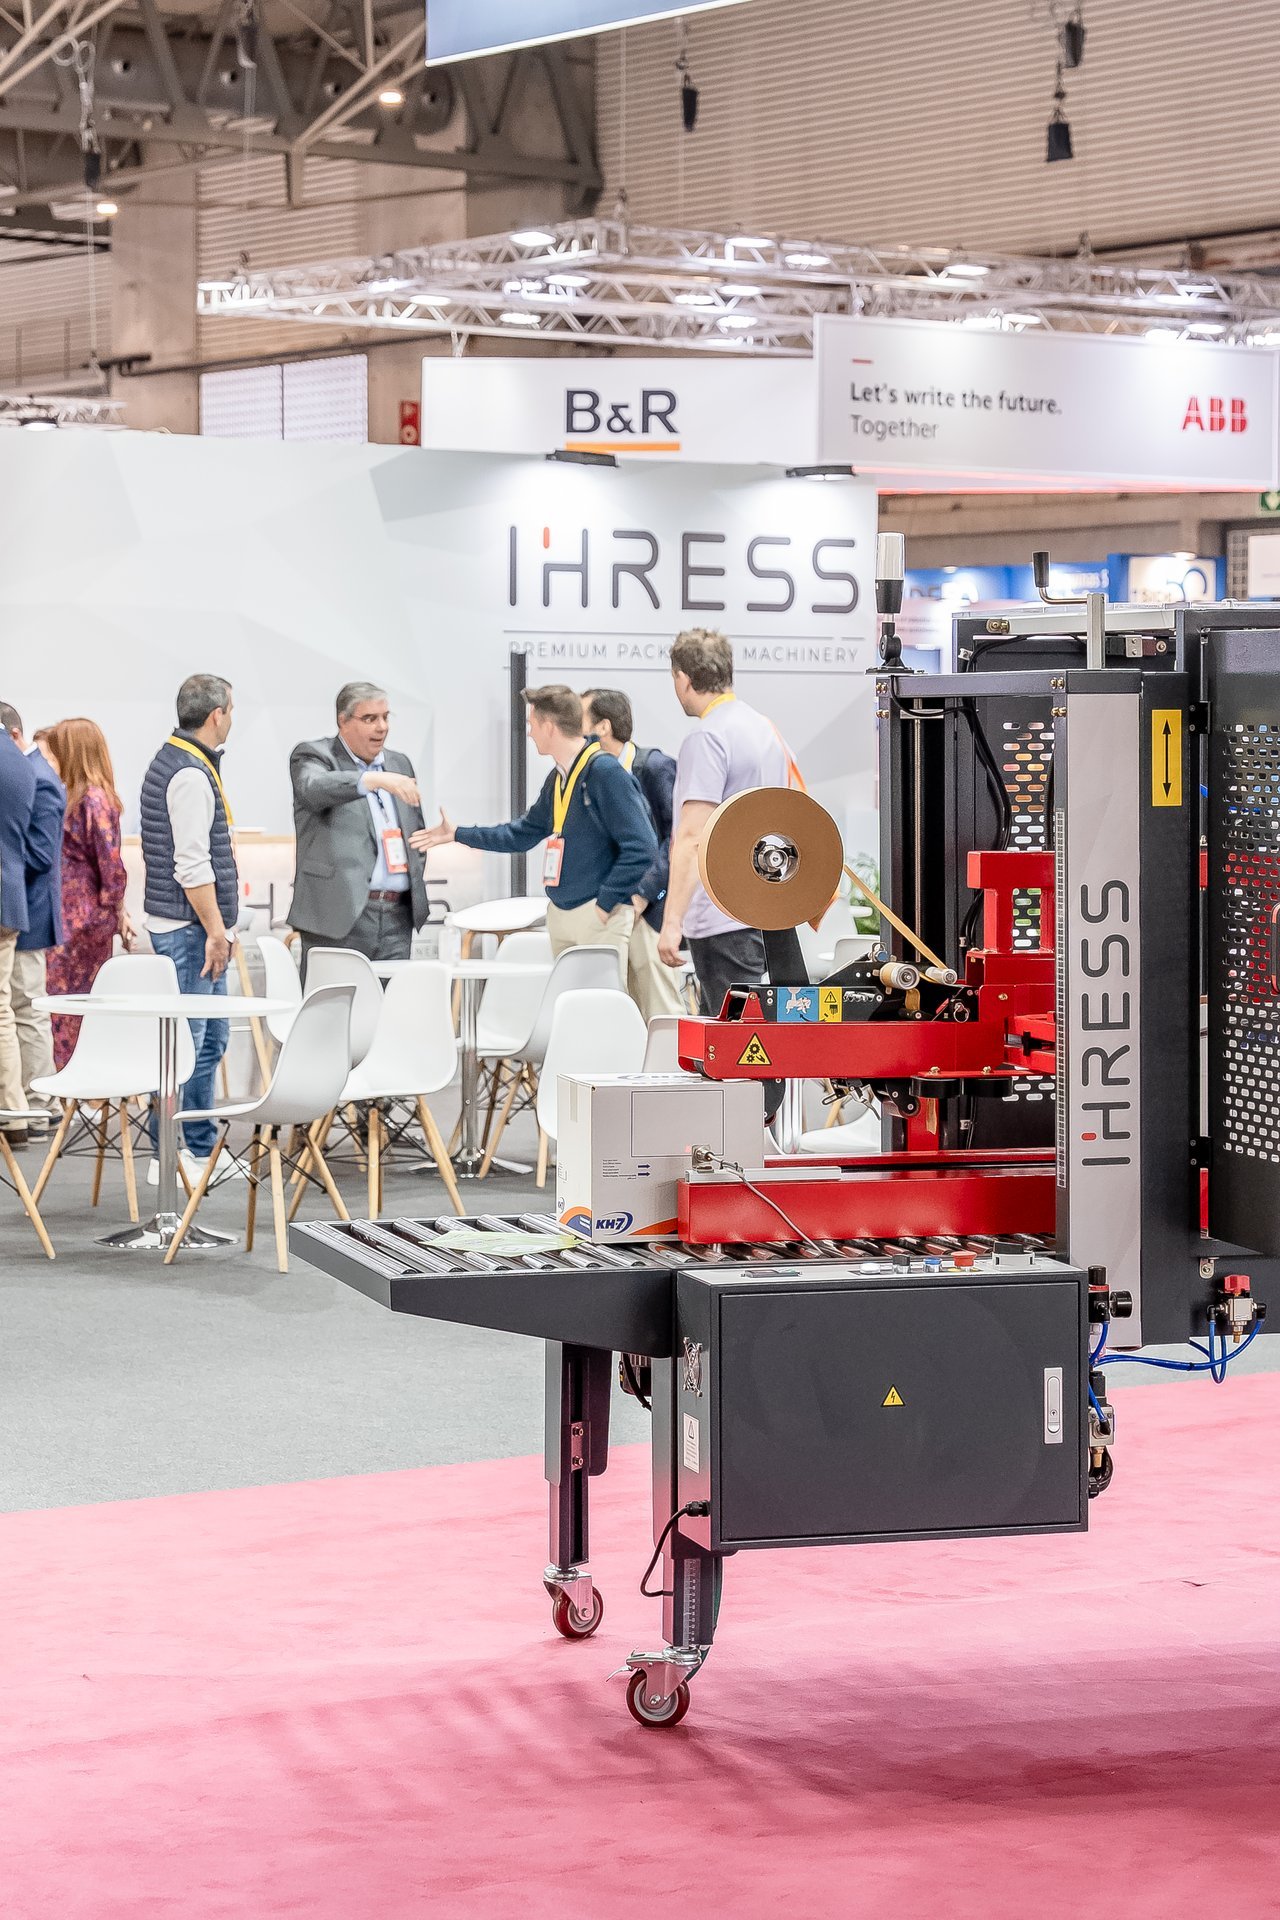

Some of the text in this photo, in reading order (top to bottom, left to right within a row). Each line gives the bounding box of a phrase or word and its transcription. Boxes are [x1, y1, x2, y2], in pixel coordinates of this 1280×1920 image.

[565, 389, 679, 435] B&R
[850, 382, 1063, 415] Let's write the future.
[1182, 397, 1247, 432] ABB
[850, 414, 939, 441] Together
[509, 525, 860, 614] IHRESS
[508, 641, 608, 658] PREMIUM
[743, 647, 859, 663] MACHINERY
[1080, 879, 1131, 1166] IHRESS
